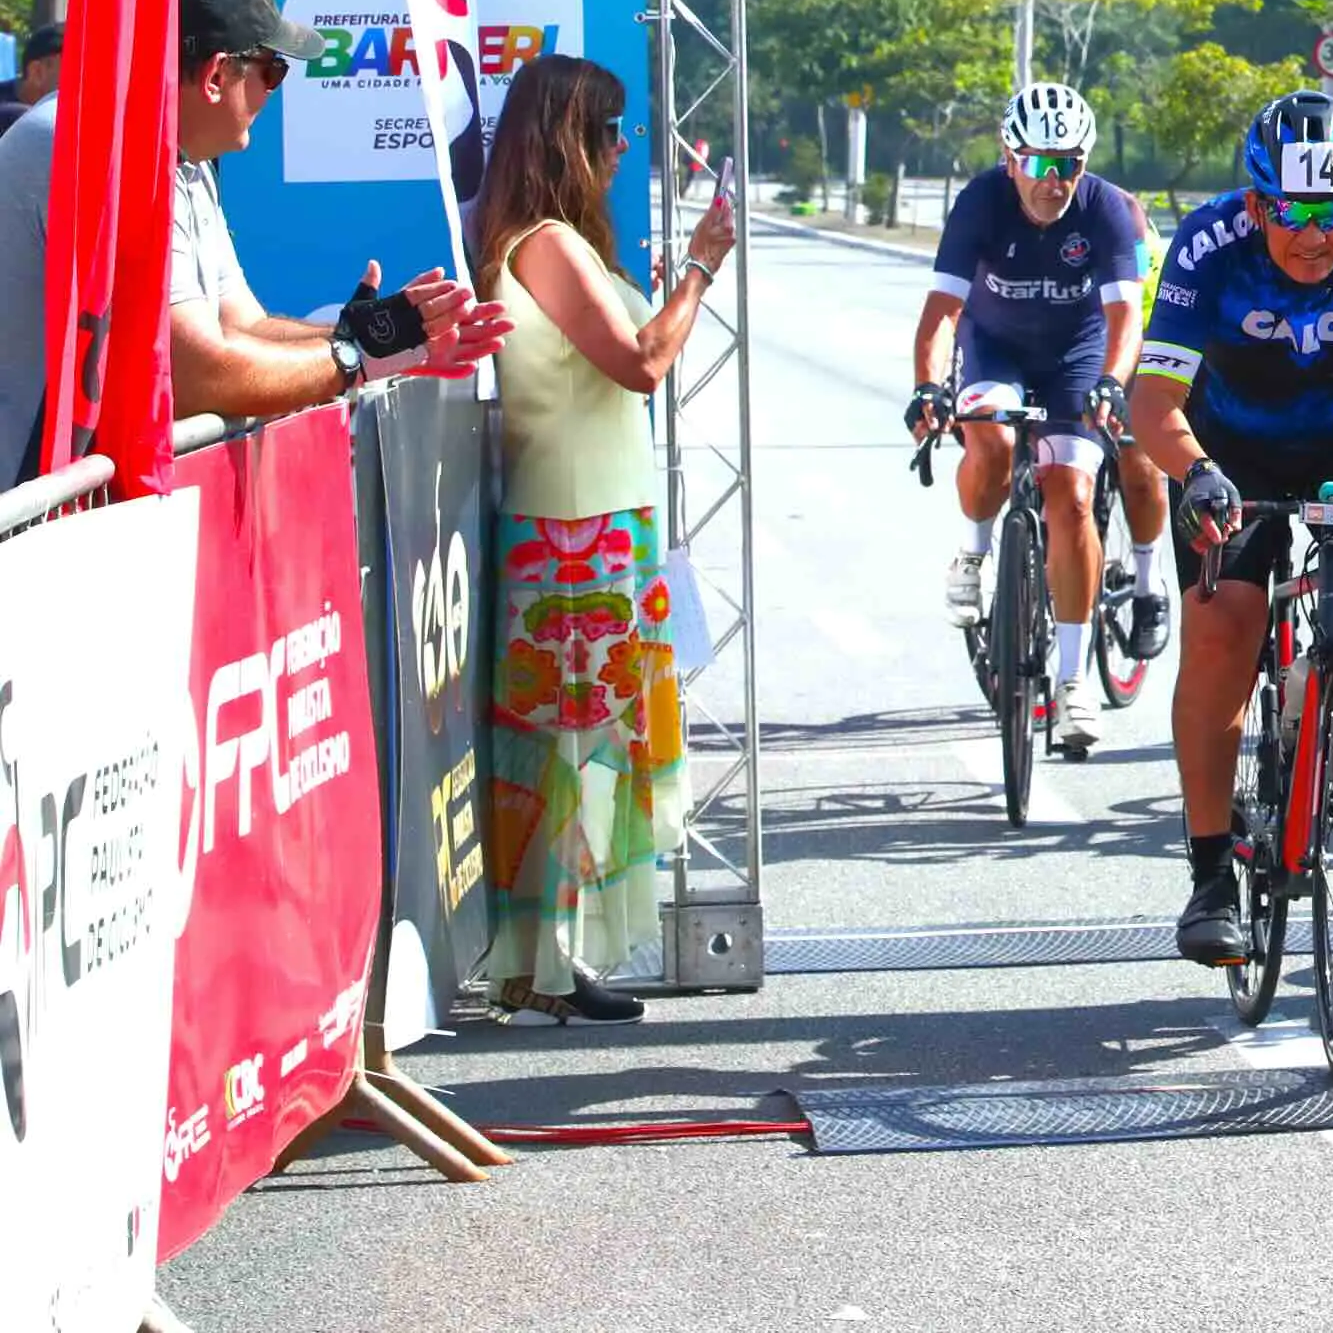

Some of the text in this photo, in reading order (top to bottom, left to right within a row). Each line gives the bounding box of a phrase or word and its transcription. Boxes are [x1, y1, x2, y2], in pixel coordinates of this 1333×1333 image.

[313, 13, 400, 26] PREFEITURA
[321, 79, 351, 89] UMA
[357, 78, 411, 89] CIDADE
[1039, 111, 1069, 140] 18
[202, 636, 290, 855] FPC
